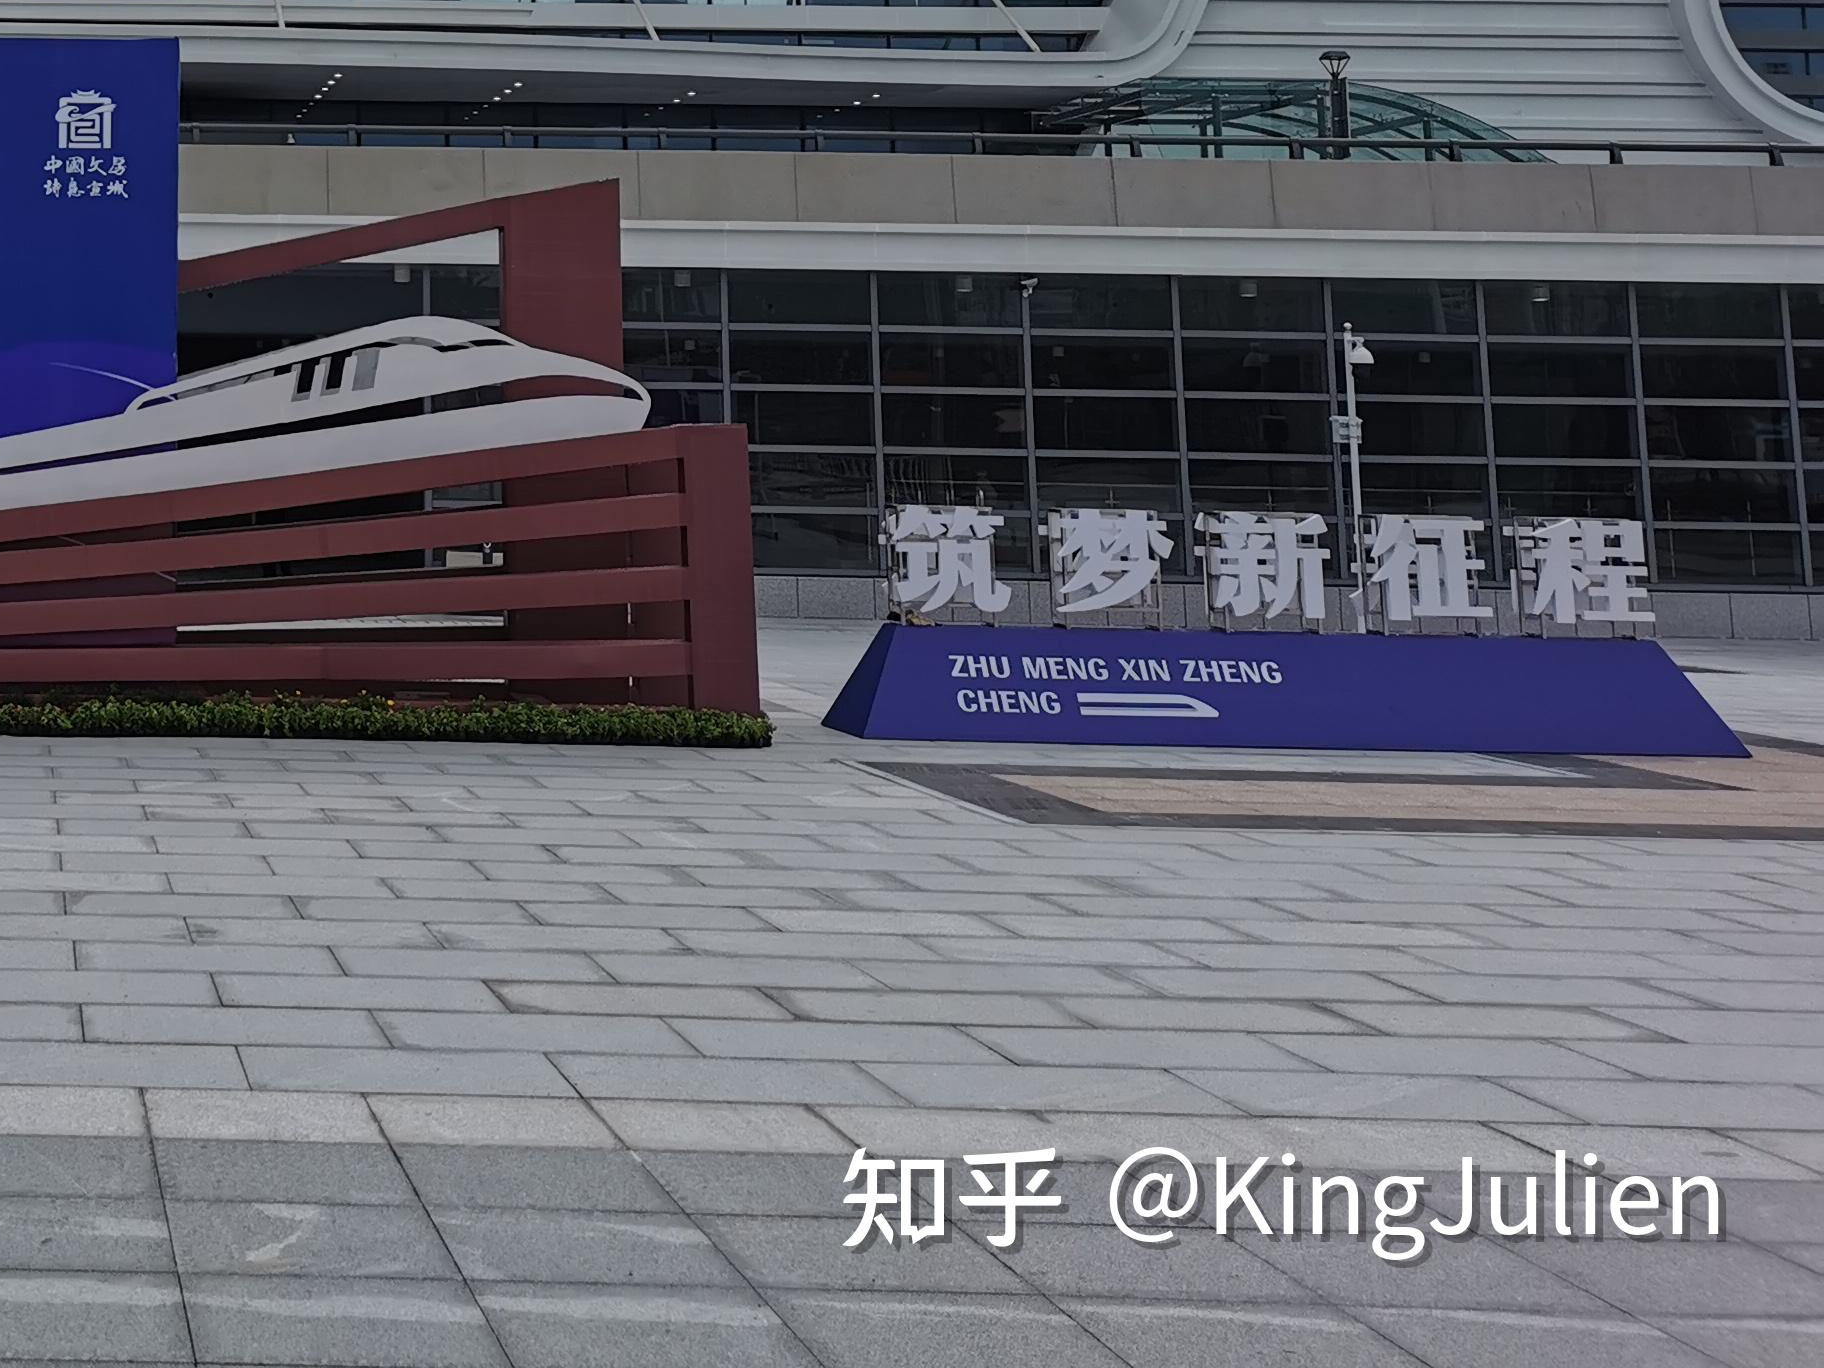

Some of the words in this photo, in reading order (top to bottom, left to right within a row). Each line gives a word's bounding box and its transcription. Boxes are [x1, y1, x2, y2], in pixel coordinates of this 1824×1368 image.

[890, 504, 1657, 625] 筑梦新征程
[948, 654, 1012, 679] ZHU
[1021, 656, 1109, 681] MENG
[1117, 658, 1171, 682] XIN
[1178, 659, 1283, 684] ZHENG
[956, 688, 1062, 715] CHENG
